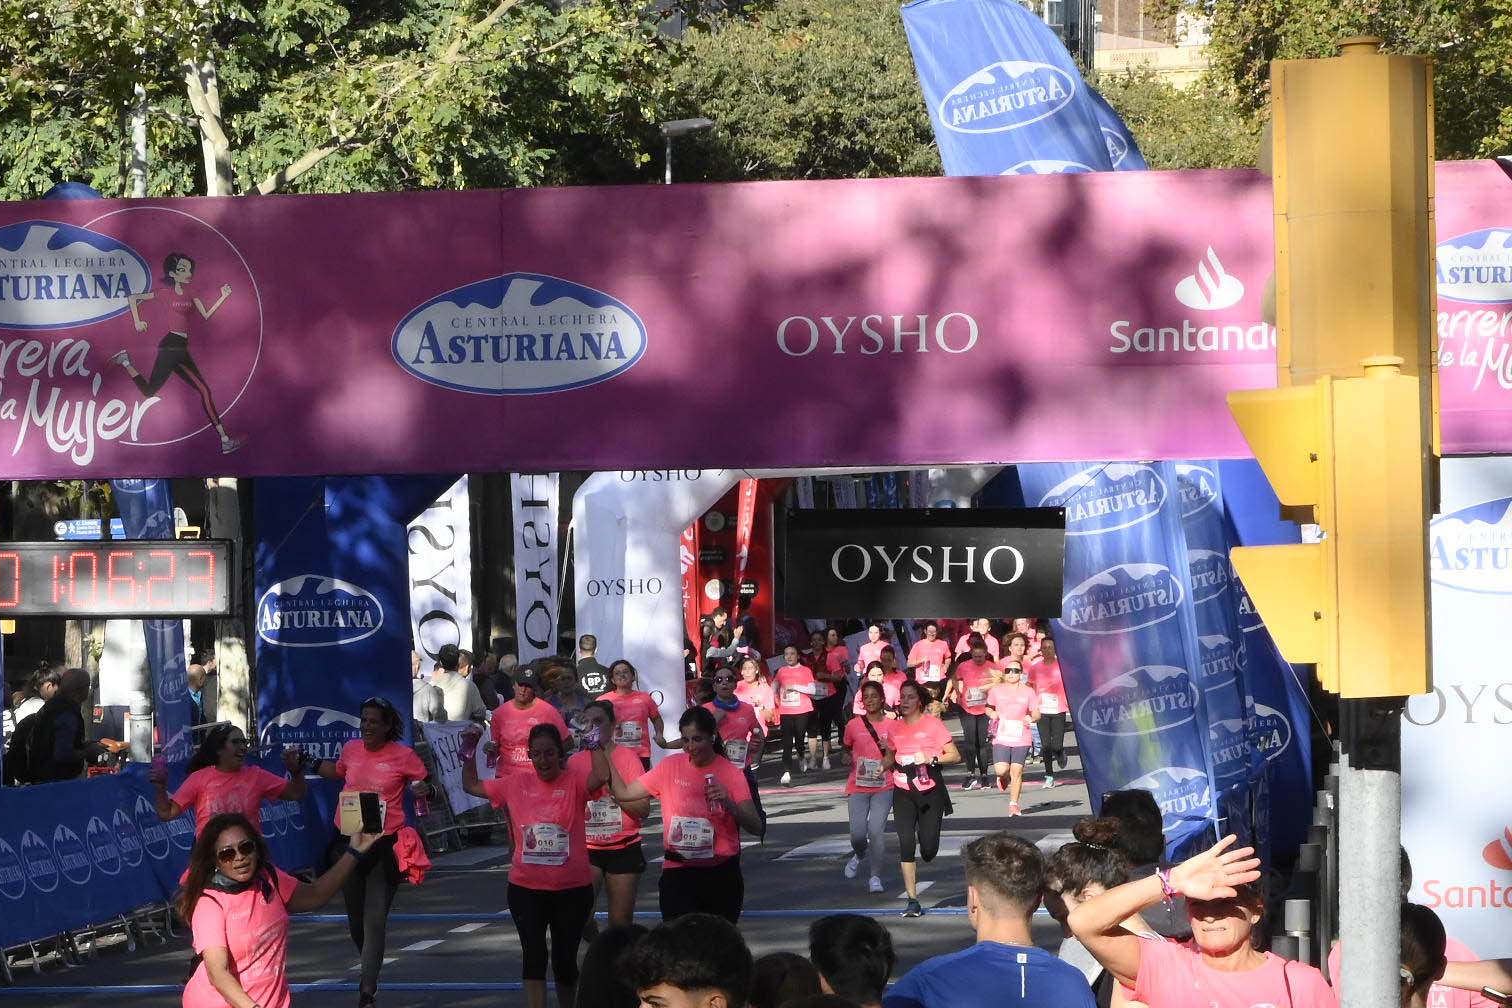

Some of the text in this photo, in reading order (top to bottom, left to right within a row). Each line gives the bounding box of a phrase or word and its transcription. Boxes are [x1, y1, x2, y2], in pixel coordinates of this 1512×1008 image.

[54, 256, 127, 268] LECHERA
[451, 313, 618, 329] CENTRAL LECHERA
[776, 312, 979, 357] OYSHO
[412, 320, 627, 365] ASTURIANA
[1110, 320, 1277, 354] Santand
[1460, 343, 1478, 368] la
[12, 373, 161, 467] Mujer
[519, 473, 553, 651] OYSH
[831, 543, 1025, 585] OYSHO
[587, 576, 663, 597] OYSHO
[261, 603, 375, 632] ASTURIANA
[587, 676, 601, 687] BP
